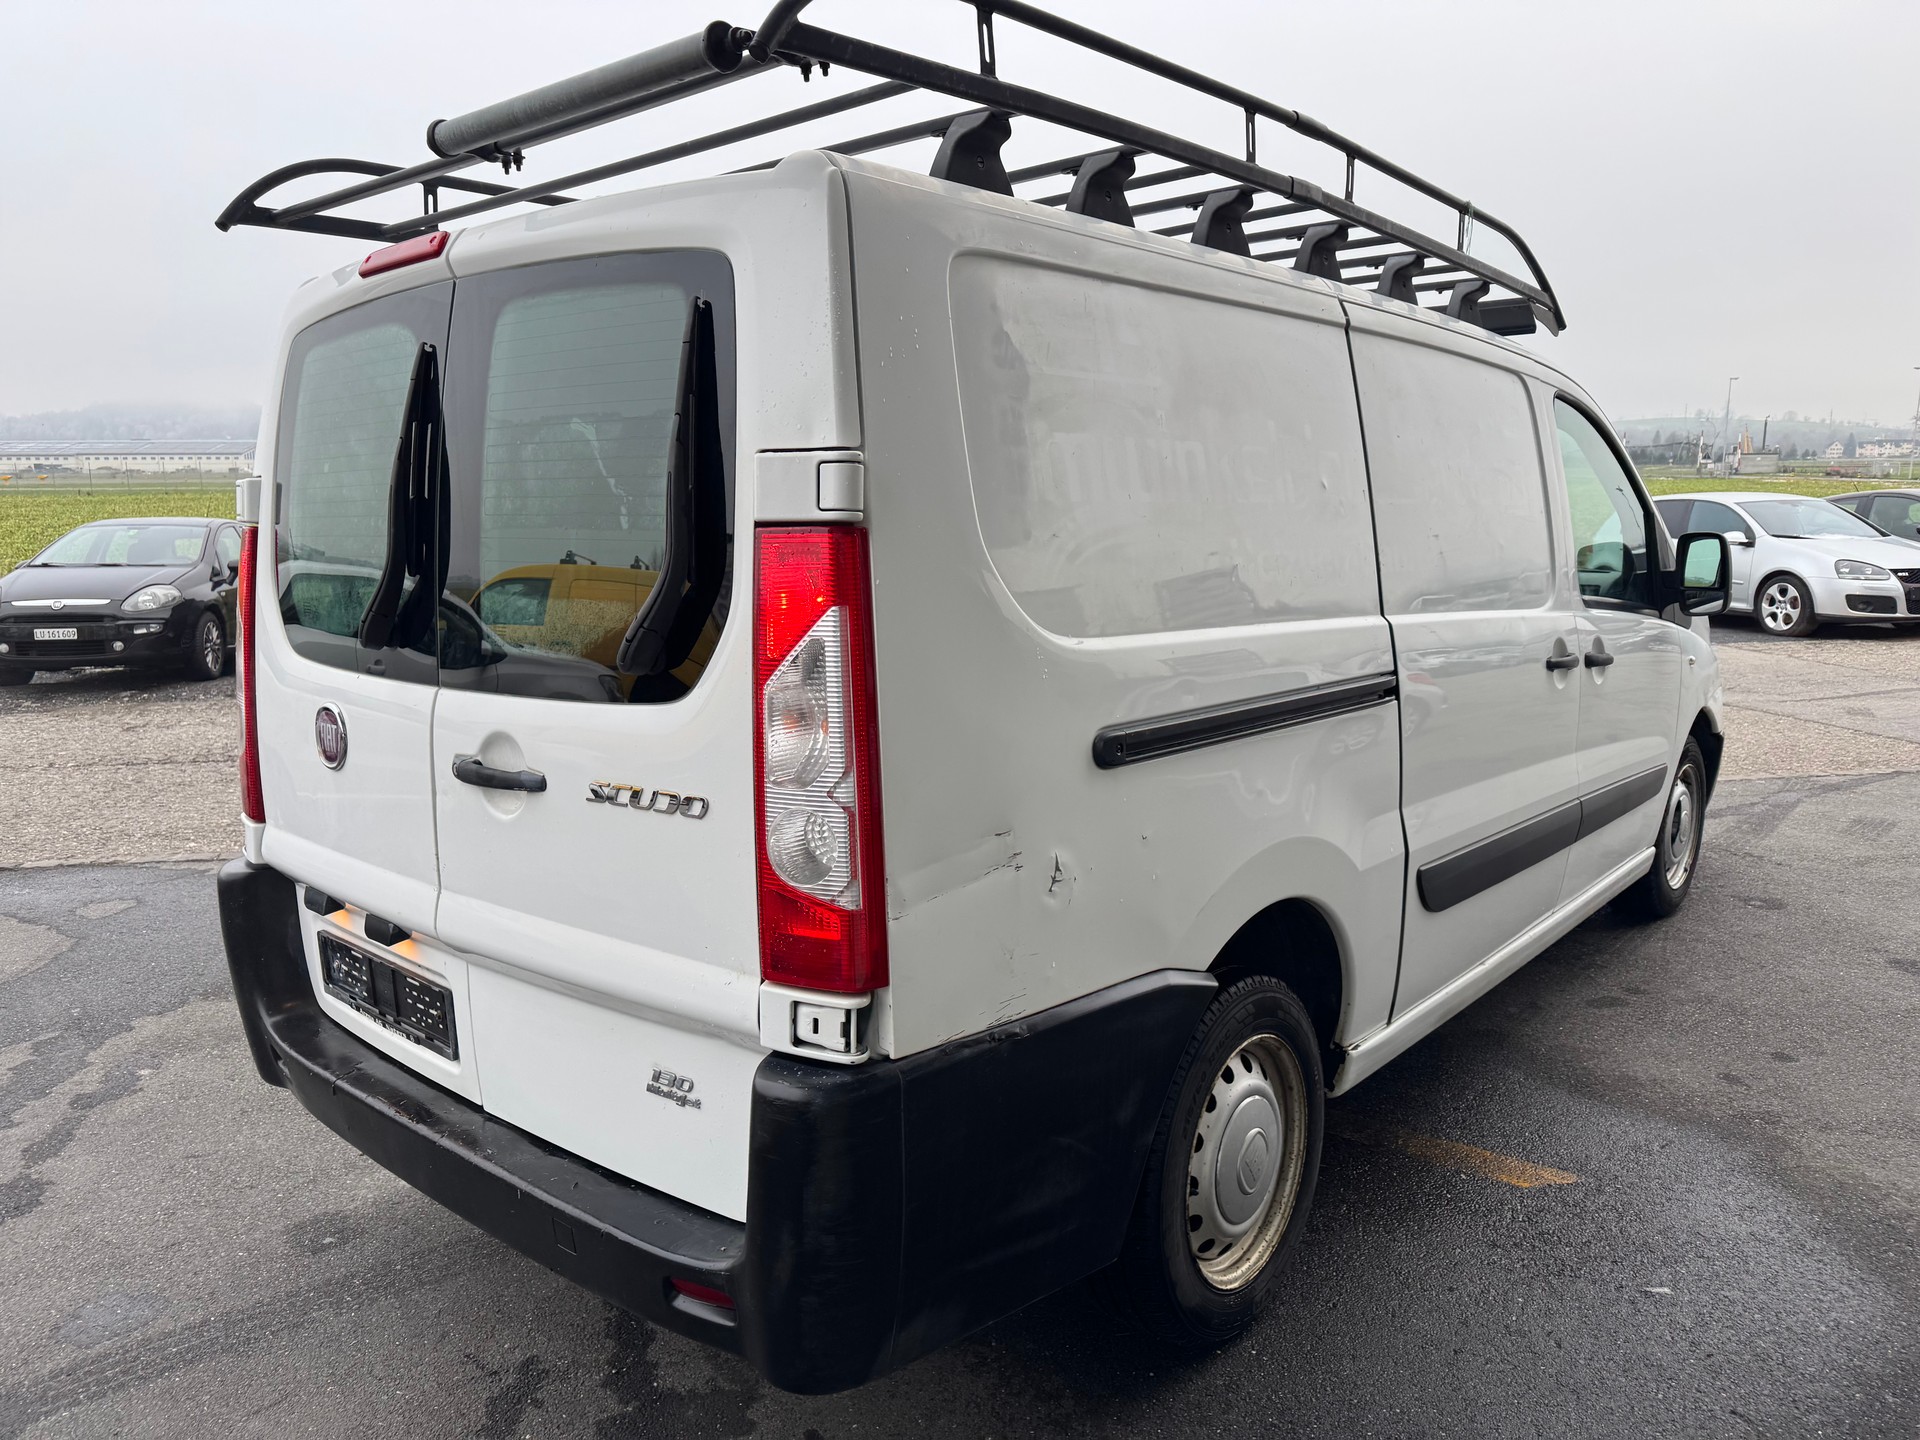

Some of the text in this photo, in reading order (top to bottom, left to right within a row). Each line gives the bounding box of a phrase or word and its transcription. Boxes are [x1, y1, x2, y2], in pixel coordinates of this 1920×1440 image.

[35, 630, 45, 638] LU
[585, 780, 710, 820] SCUDO
[651, 1067, 694, 1093] 130
